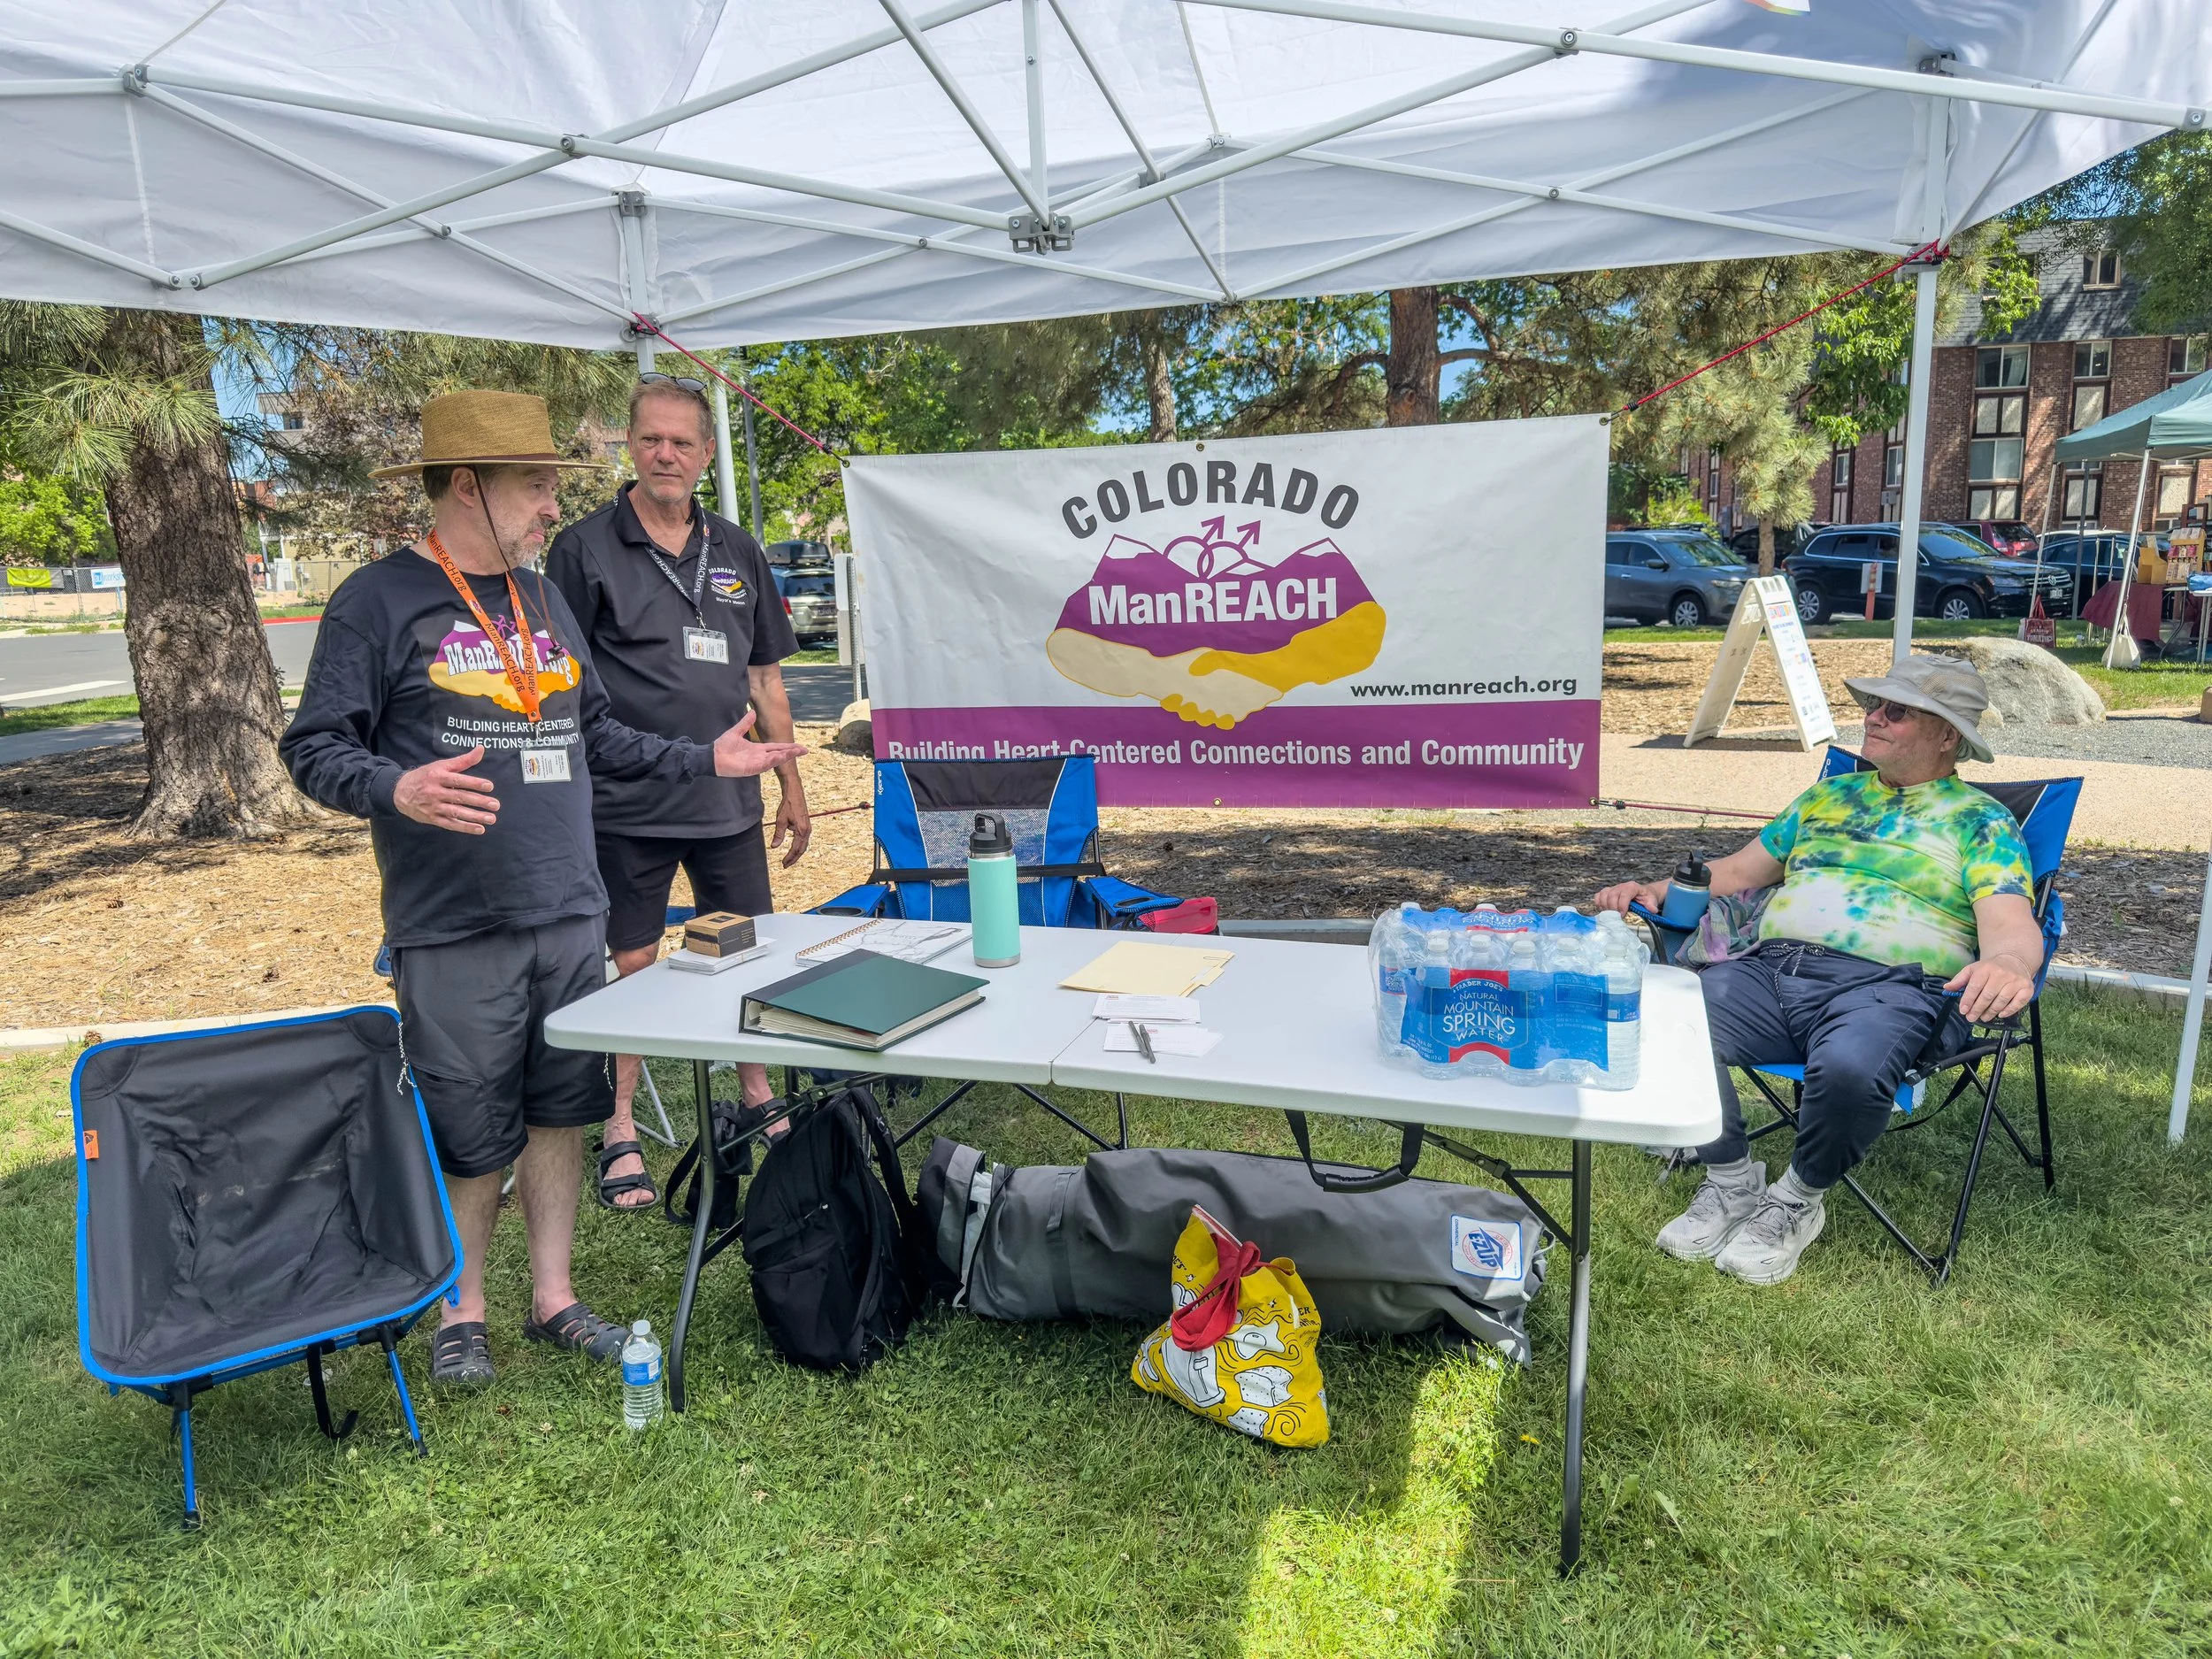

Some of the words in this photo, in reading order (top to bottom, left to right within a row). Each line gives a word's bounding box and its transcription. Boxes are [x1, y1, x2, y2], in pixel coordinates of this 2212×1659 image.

[1062, 460, 1359, 540] COLORADO
[694, 542, 709, 593] ManREACH.org
[708, 567, 737, 576] COLORADO
[1088, 577, 1337, 626] ManREACH
[485, 623, 526, 693] ManREACH.org
[525, 628, 535, 695] ManREACH.org
[1350, 675, 1578, 696] www.manreach.org
[447, 717, 501, 733] BUILDING
[442, 733, 523, 749] CONNECTIONS
[1190, 739, 1352, 765] Connections
[1361, 740, 1411, 765] and
[1421, 737, 1585, 771] Community
[1455, 980, 1482, 992] TRADER
[1483, 981, 1504, 992] JOE'S
[1460, 992, 1499, 1001] NATURAL
[1443, 1001, 1514, 1017] MOUNTAIN
[1442, 1011, 1516, 1035] SPRING
[1455, 1027, 1504, 1044] WATER
